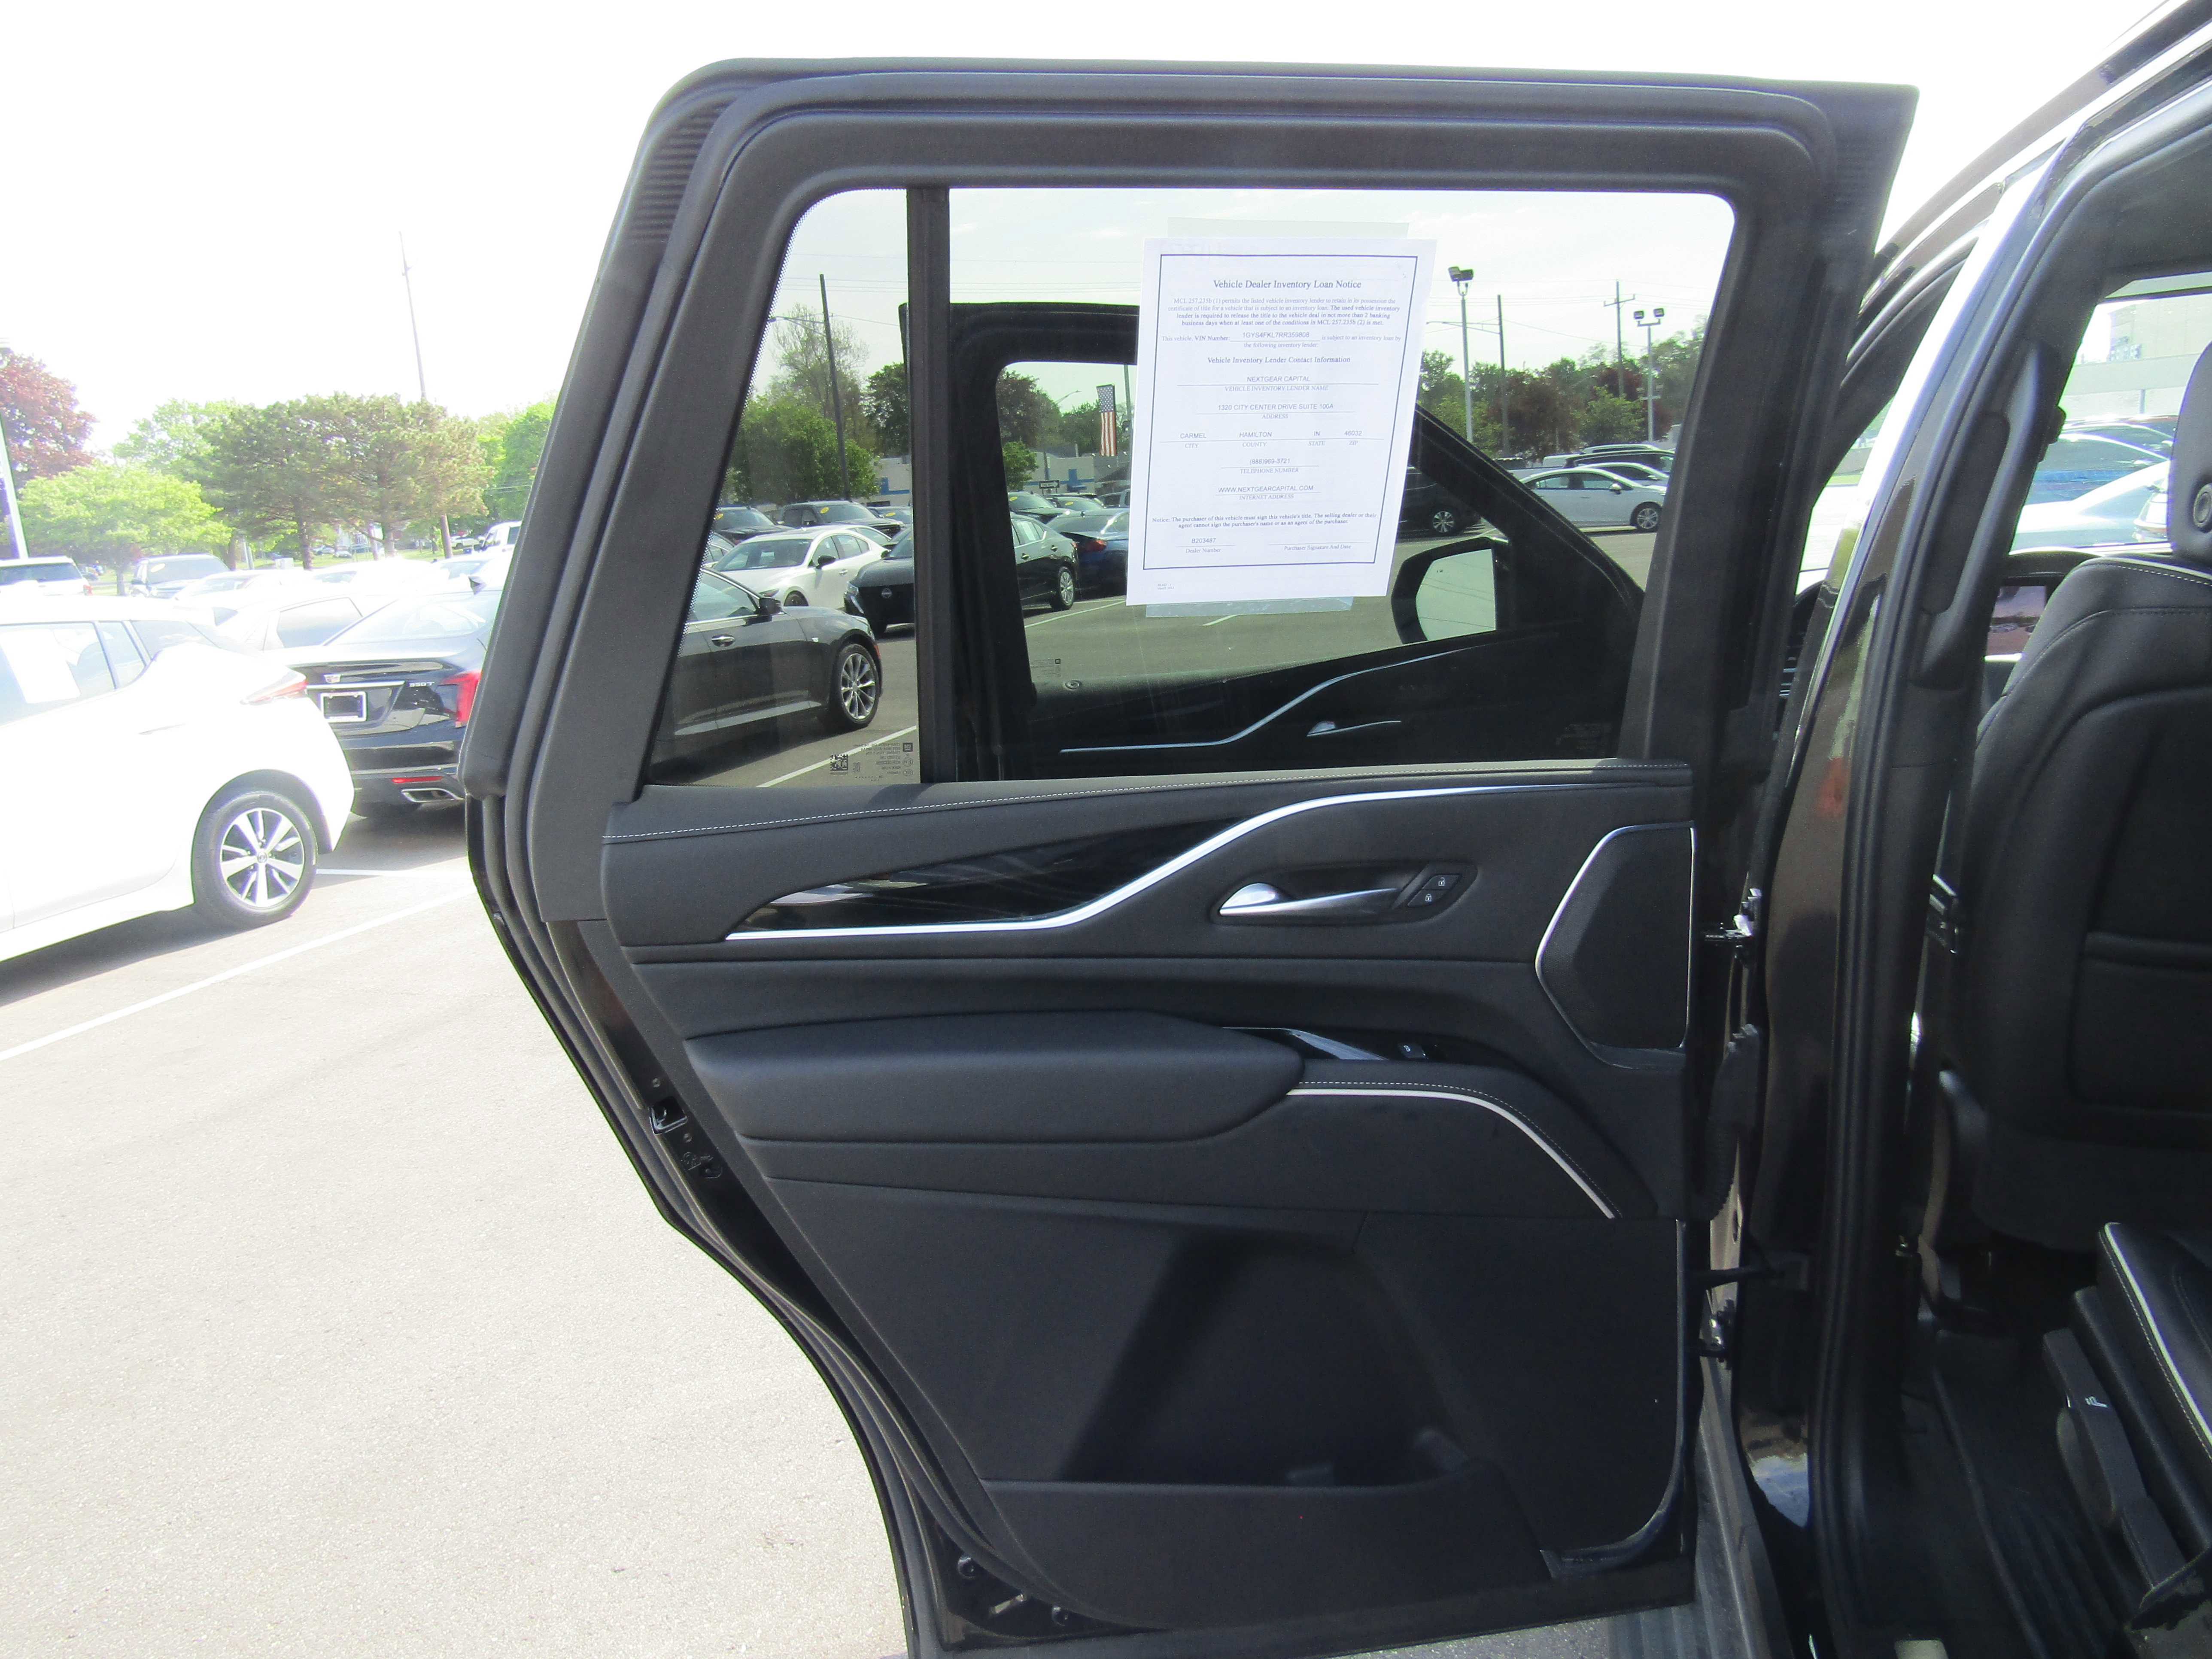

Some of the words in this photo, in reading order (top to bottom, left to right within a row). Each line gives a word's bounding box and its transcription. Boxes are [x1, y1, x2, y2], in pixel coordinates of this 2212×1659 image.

[1214, 280, 1243, 288] Vehicle
[1246, 280, 1271, 288] Dealer
[1274, 280, 1311, 290] Inventory
[1314, 280, 1333, 288] Loan
[1336, 280, 1361, 288] Notice
